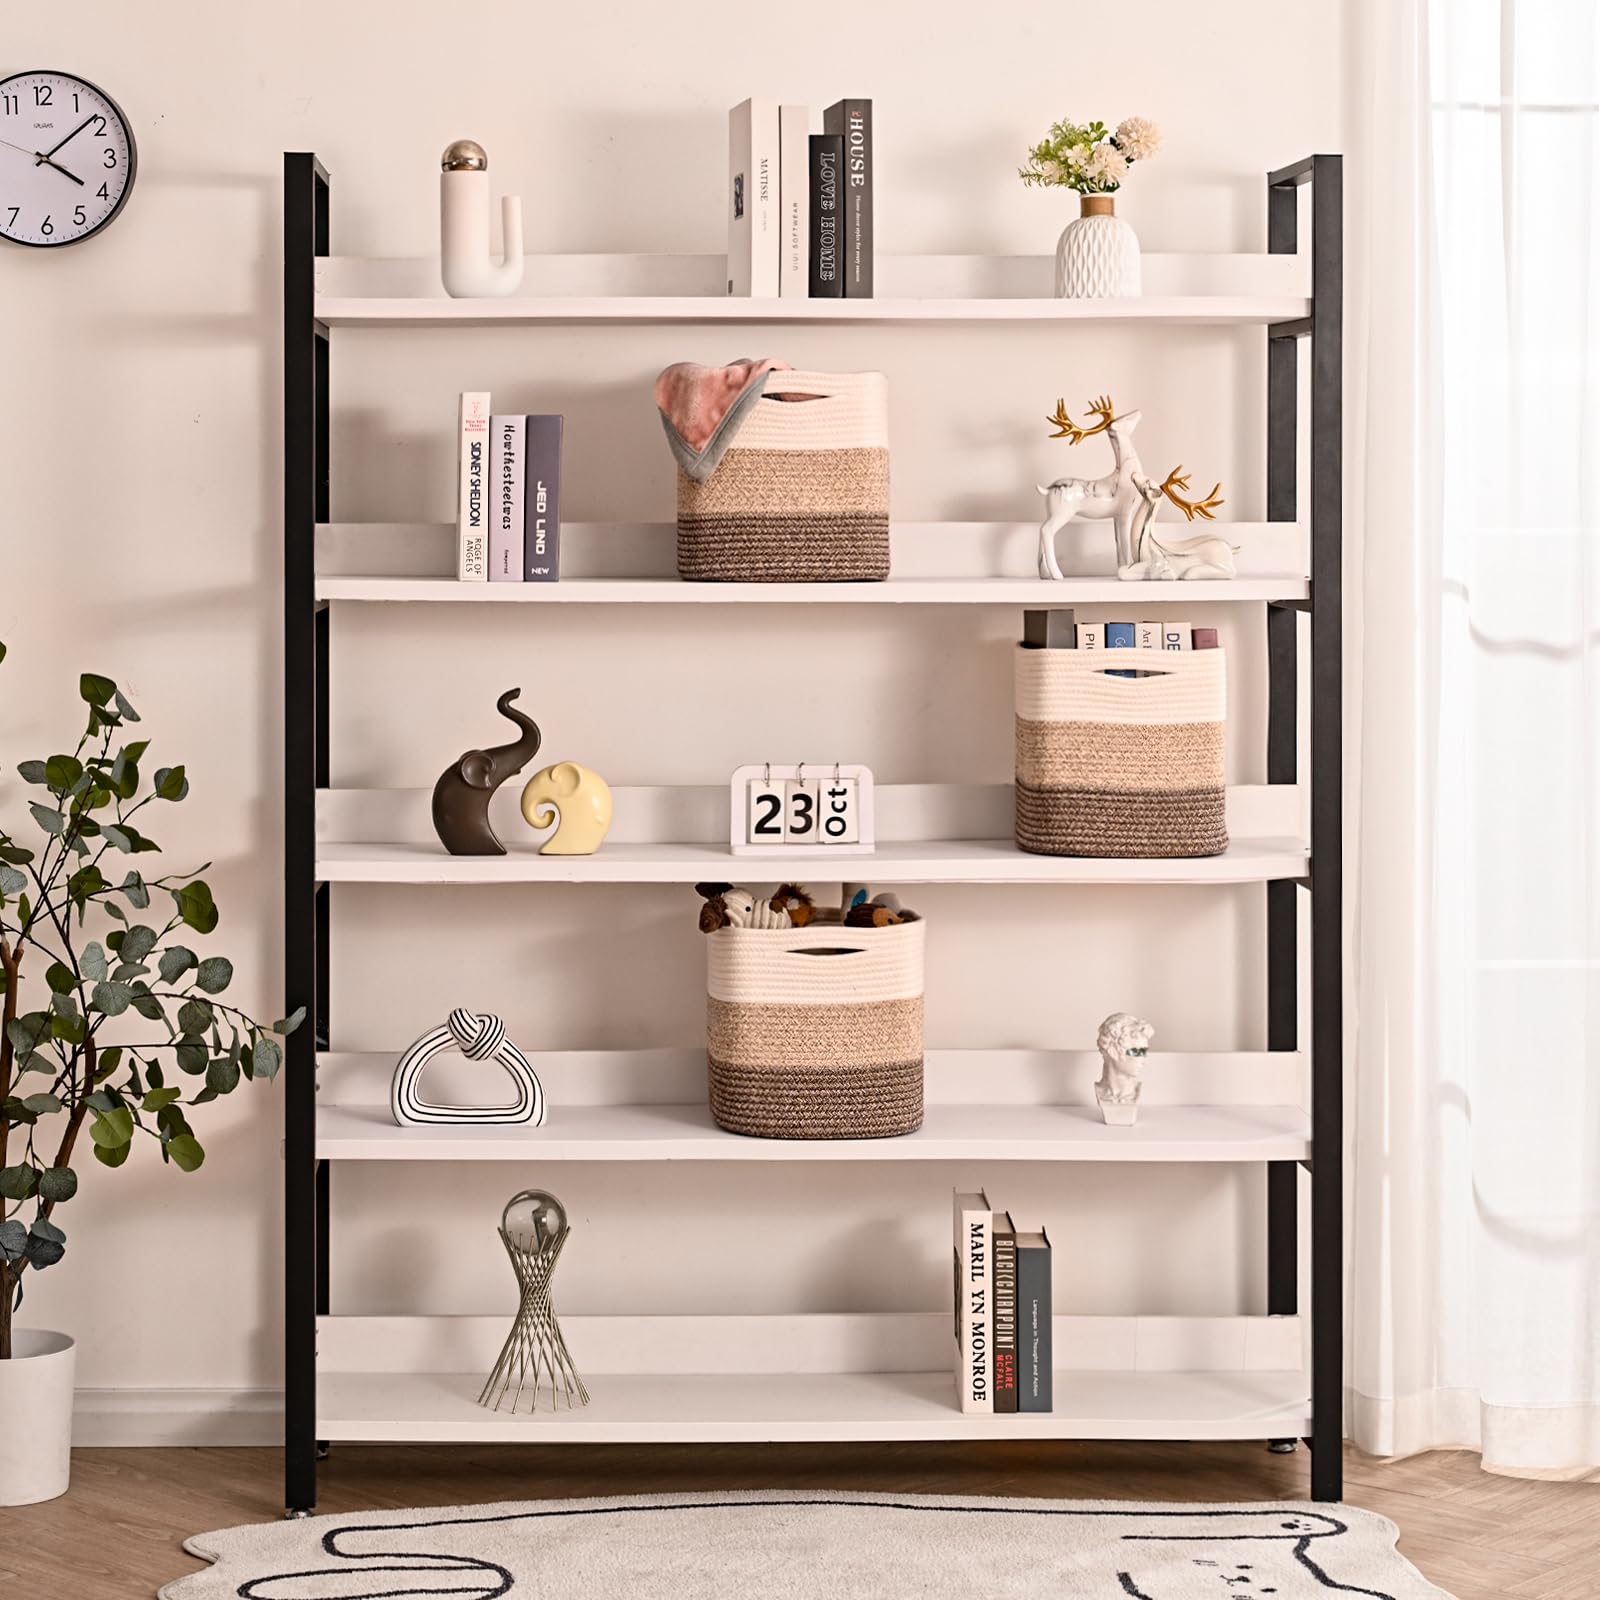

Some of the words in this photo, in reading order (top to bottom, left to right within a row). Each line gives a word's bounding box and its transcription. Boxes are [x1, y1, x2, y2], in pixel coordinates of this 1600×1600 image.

[3, 95, 18, 115] 11
[33, 86, 53, 106] 12
[72, 93, 79, 113] 1
[93, 116, 107, 136] 2
[104, 148, 117, 168] 3
[850, 118, 864, 188] HOUSE
[96, 181, 109, 200] 4
[760, 158, 768, 202] MATISSE
[820, 153, 835, 210] LOVE
[8, 207, 20, 227] 7
[41, 215, 54, 235] 6
[73, 205, 86, 225] 5
[820, 217, 835, 281] HOME
[470, 441, 481, 477] SIDNEY
[470, 478, 481, 527] SHELDON
[536, 481, 546, 513] JED
[535, 519, 546, 554] LIND
[465, 540, 473, 573] ANGELS
[474, 563, 482, 575] OF
[531, 567, 550, 575] NEW
[1142, 629, 1152, 643] Art
[825, 788, 847, 837] Oct
[971, 1223, 984, 1282] MARIL
[971, 1289, 985, 1315] YN
[972, 1322, 986, 1401] MONROE
[996, 1354, 1004, 1391] MCFALL
[1005, 1354, 1014, 1389] CLAIRE
